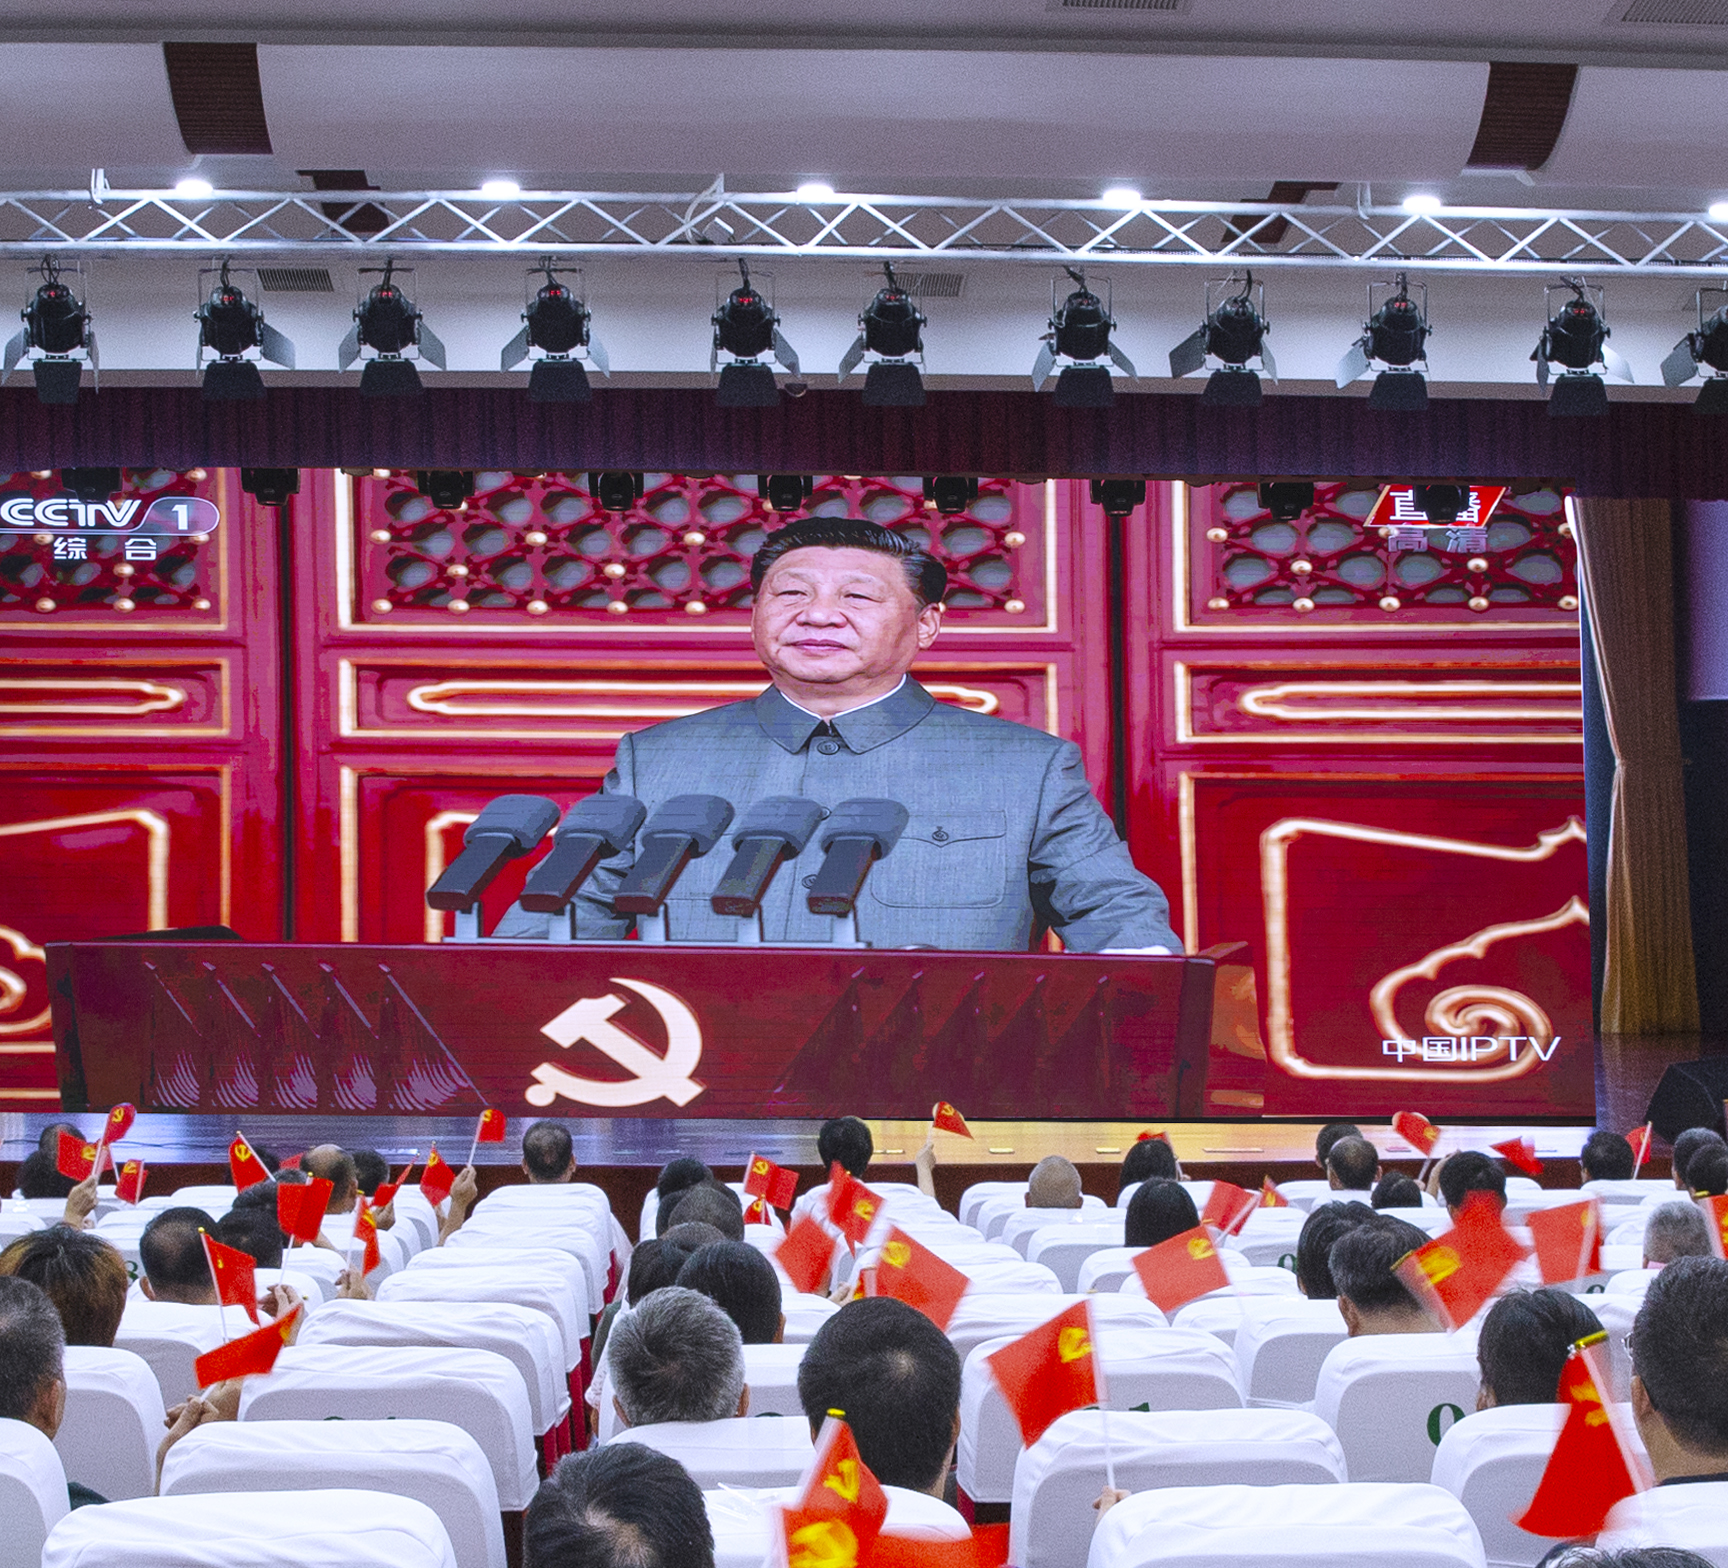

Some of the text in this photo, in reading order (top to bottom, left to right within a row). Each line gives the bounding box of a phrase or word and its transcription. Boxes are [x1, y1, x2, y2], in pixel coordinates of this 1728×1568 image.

[0, 497, 141, 527] CCTV
[53, 537, 157, 560] 综合
[1382, 1036, 1561, 1063] 中国IPTV
[1427, 1403, 1467, 1447] 0
